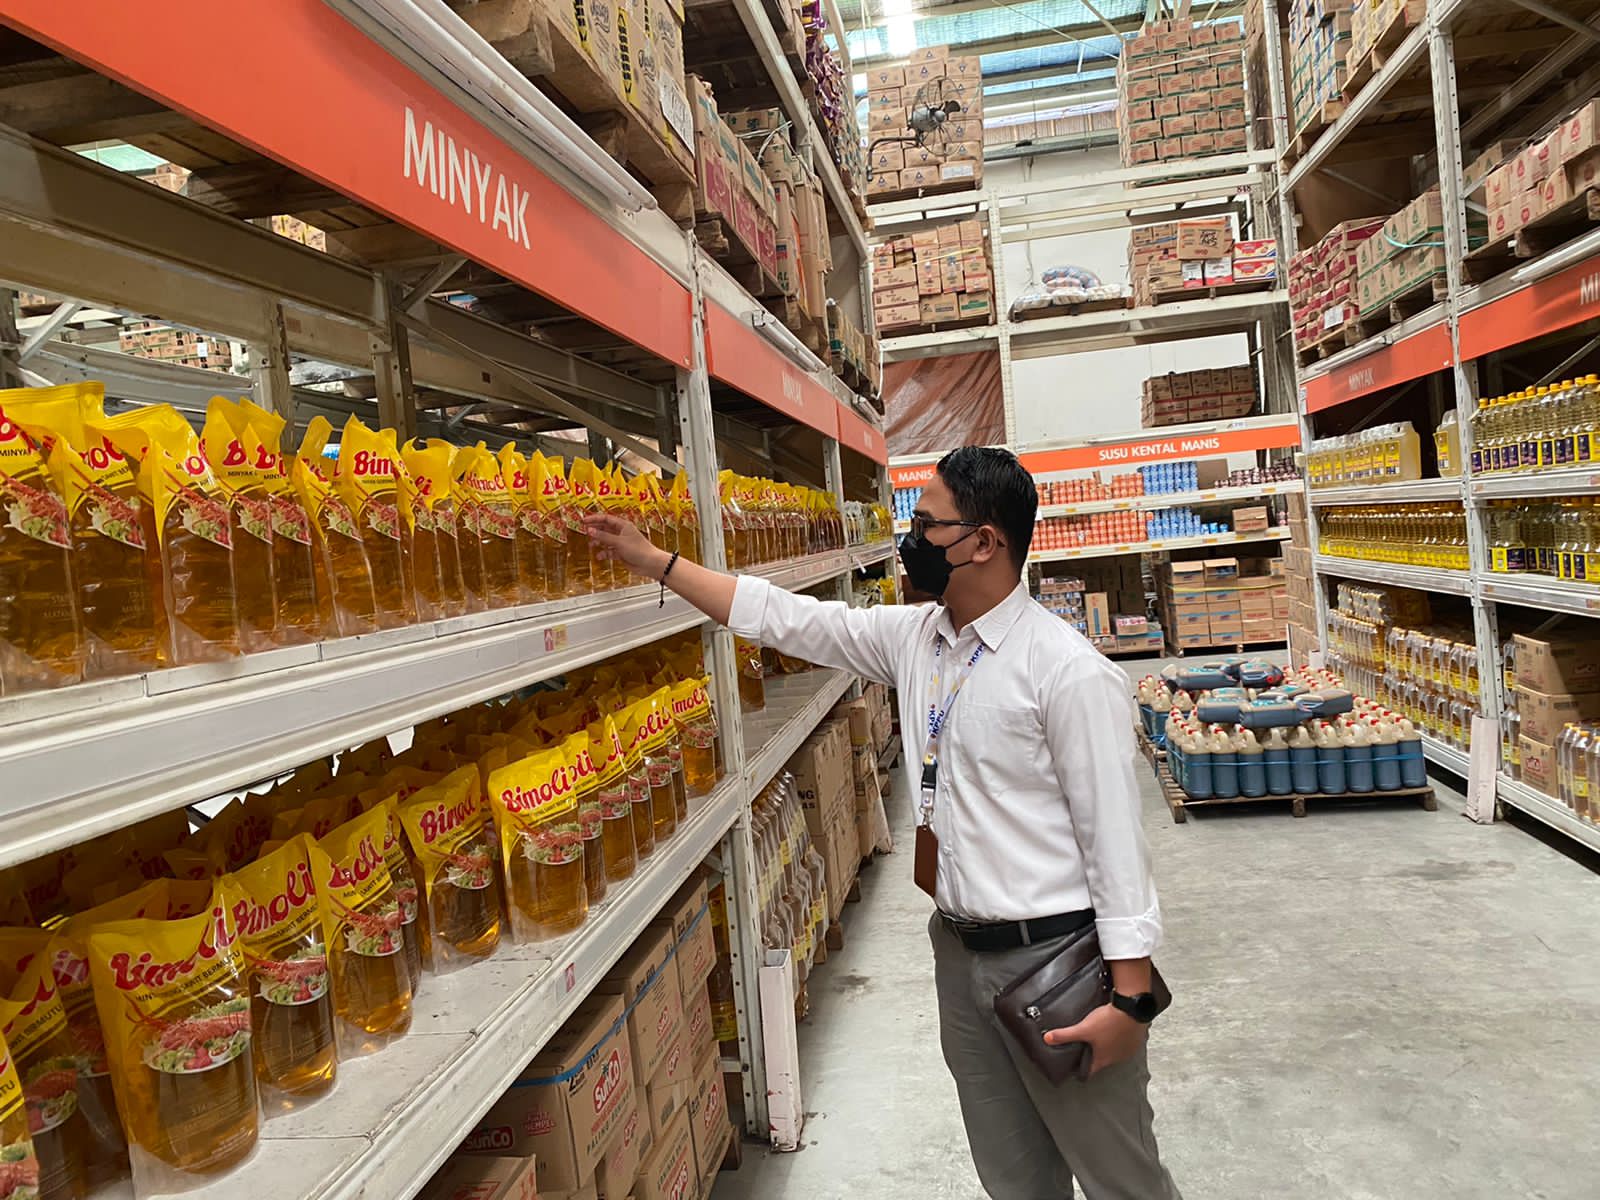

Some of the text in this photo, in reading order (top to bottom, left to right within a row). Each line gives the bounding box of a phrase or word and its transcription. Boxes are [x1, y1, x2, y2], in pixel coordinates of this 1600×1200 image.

[403, 105, 532, 250] MINYAK
[1580, 272, 1600, 305] MI
[1099, 437, 1220, 461] SUSU KENTAL MANIS
[898, 469, 934, 483] MANIS
[931, 709, 945, 735] KPPU
[501, 766, 572, 813] Bimoli
